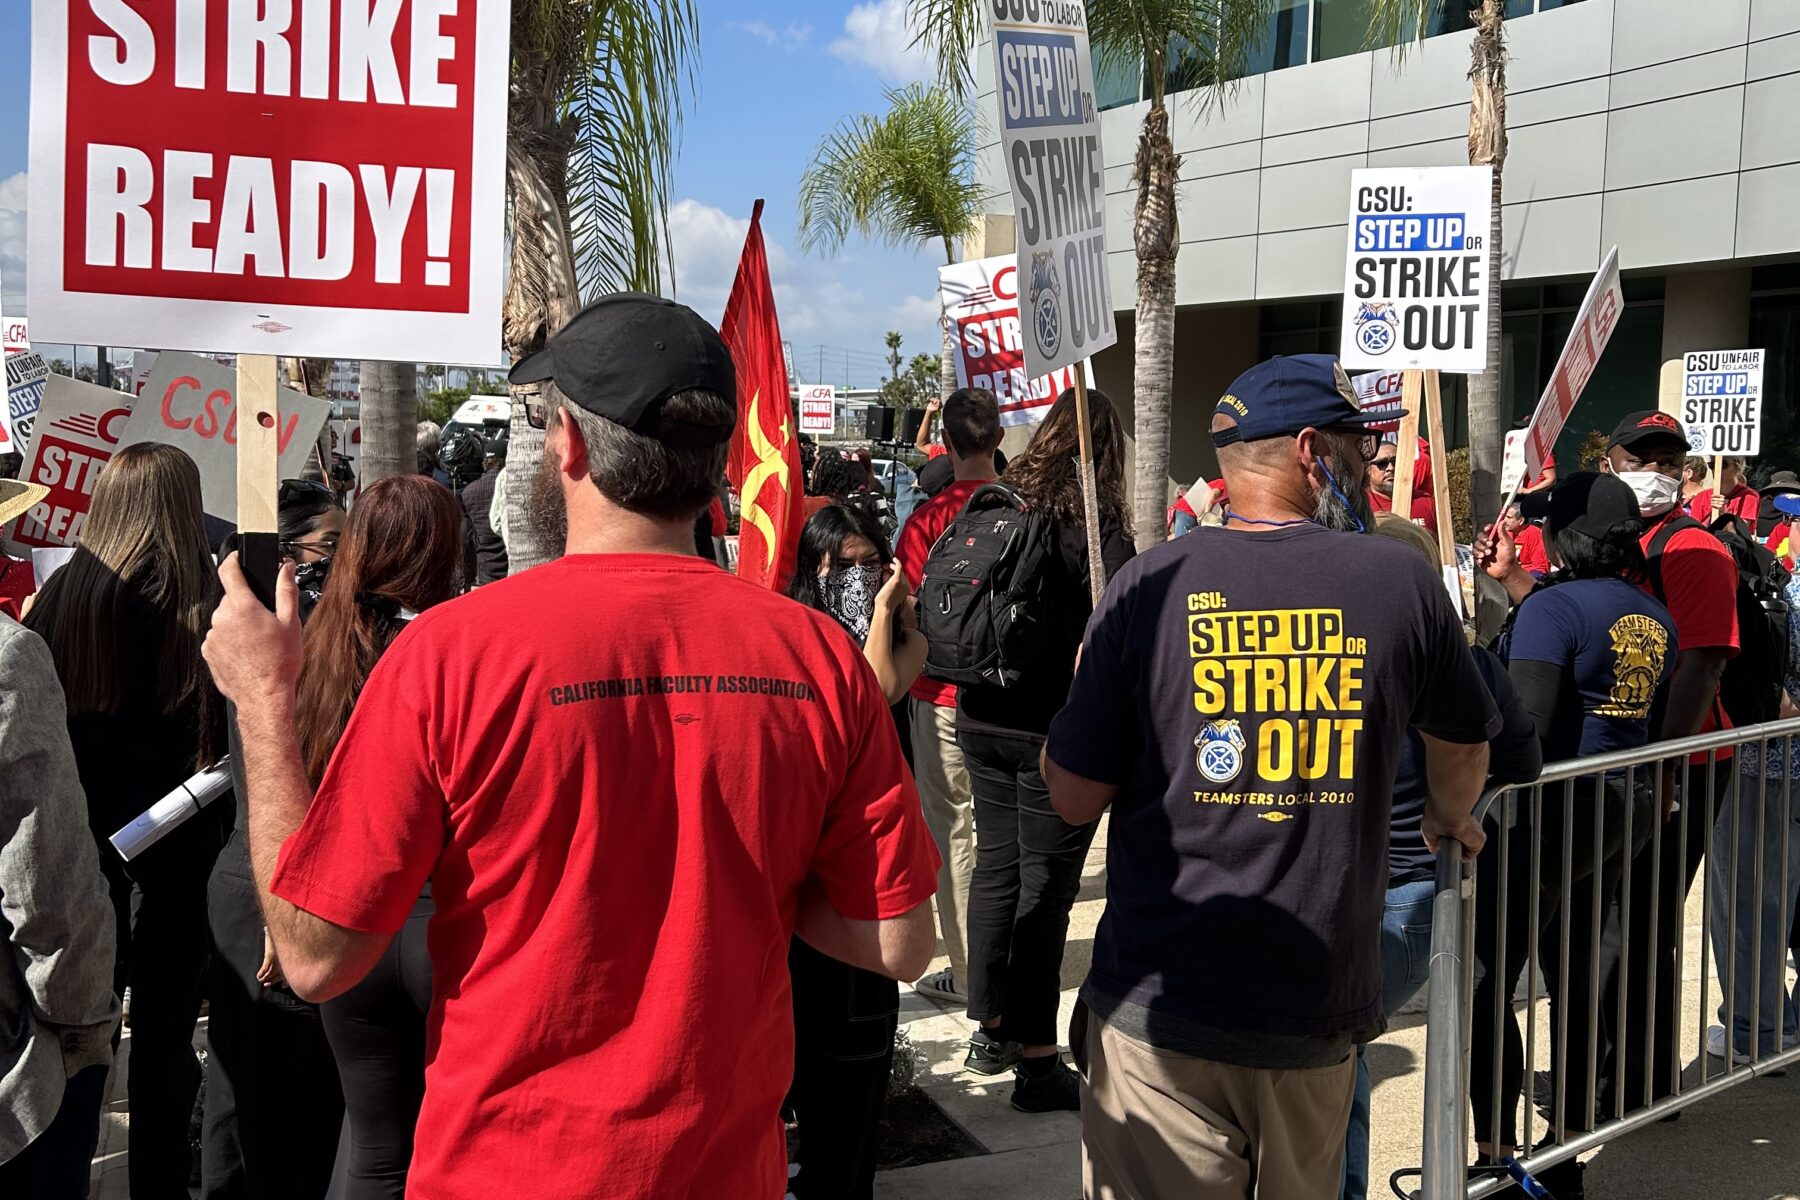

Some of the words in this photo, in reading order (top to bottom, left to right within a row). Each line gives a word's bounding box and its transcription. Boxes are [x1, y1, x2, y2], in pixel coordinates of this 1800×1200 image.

[1041, 2, 1055, 23] TO
[1057, 3, 1083, 26] LABOR
[88, 0, 457, 108] STRIKE
[1003, 42, 1053, 121] STEP
[1054, 46, 1081, 118] UP
[1082, 92, 1095, 123] OR
[1012, 135, 1102, 247] STRIKE
[1358, 186, 1413, 212] CSU:
[86, 143, 455, 286] READY!
[1358, 218, 1421, 249] STEP
[1426, 217, 1463, 249] UP
[1466, 236, 1482, 250] OR
[1354, 256, 1481, 299] STRIKE
[1064, 234, 1110, 349] OUT
[9, 324, 27, 342] CFA
[963, 316, 1023, 359] STR
[1403, 304, 1480, 350] OUT
[16, 354, 46, 374] UNFAIR
[1687, 353, 1720, 372] CSU
[1722, 352, 1759, 364] UNFAIR
[1734, 363, 1759, 371] LABOR
[21, 371, 31, 382] TO
[1687, 375, 1723, 395] STEP
[1725, 374, 1747, 394] UP
[1747, 385, 1758, 395] OR
[9, 387, 37, 417] STEP
[812, 388, 831, 398] CFA
[803, 401, 831, 413] STRIKE
[1233, 400, 1249, 417] 2010
[1685, 398, 1756, 424] STRIKE
[803, 416, 831, 428] READY!
[1712, 424, 1755, 452] OUT
[1188, 591, 1227, 611] CSU:
[1191, 613, 1280, 655] STEP
[1291, 613, 1340, 651] UP
[1346, 636, 1366, 655] OR
[1611, 615, 1668, 640] TEAMSTERS
[551, 678, 643, 706] CALIFORNIA
[646, 675, 713, 695] FACULTY
[716, 675, 816, 702] ASSOCIATION
[1193, 658, 1364, 714] STRIKE
[1257, 718, 1363, 782] OUT
[1193, 791, 1274, 806] TEAMSTERS
[1278, 792, 1315, 806] LOCAL
[1319, 791, 1354, 804] 2010
